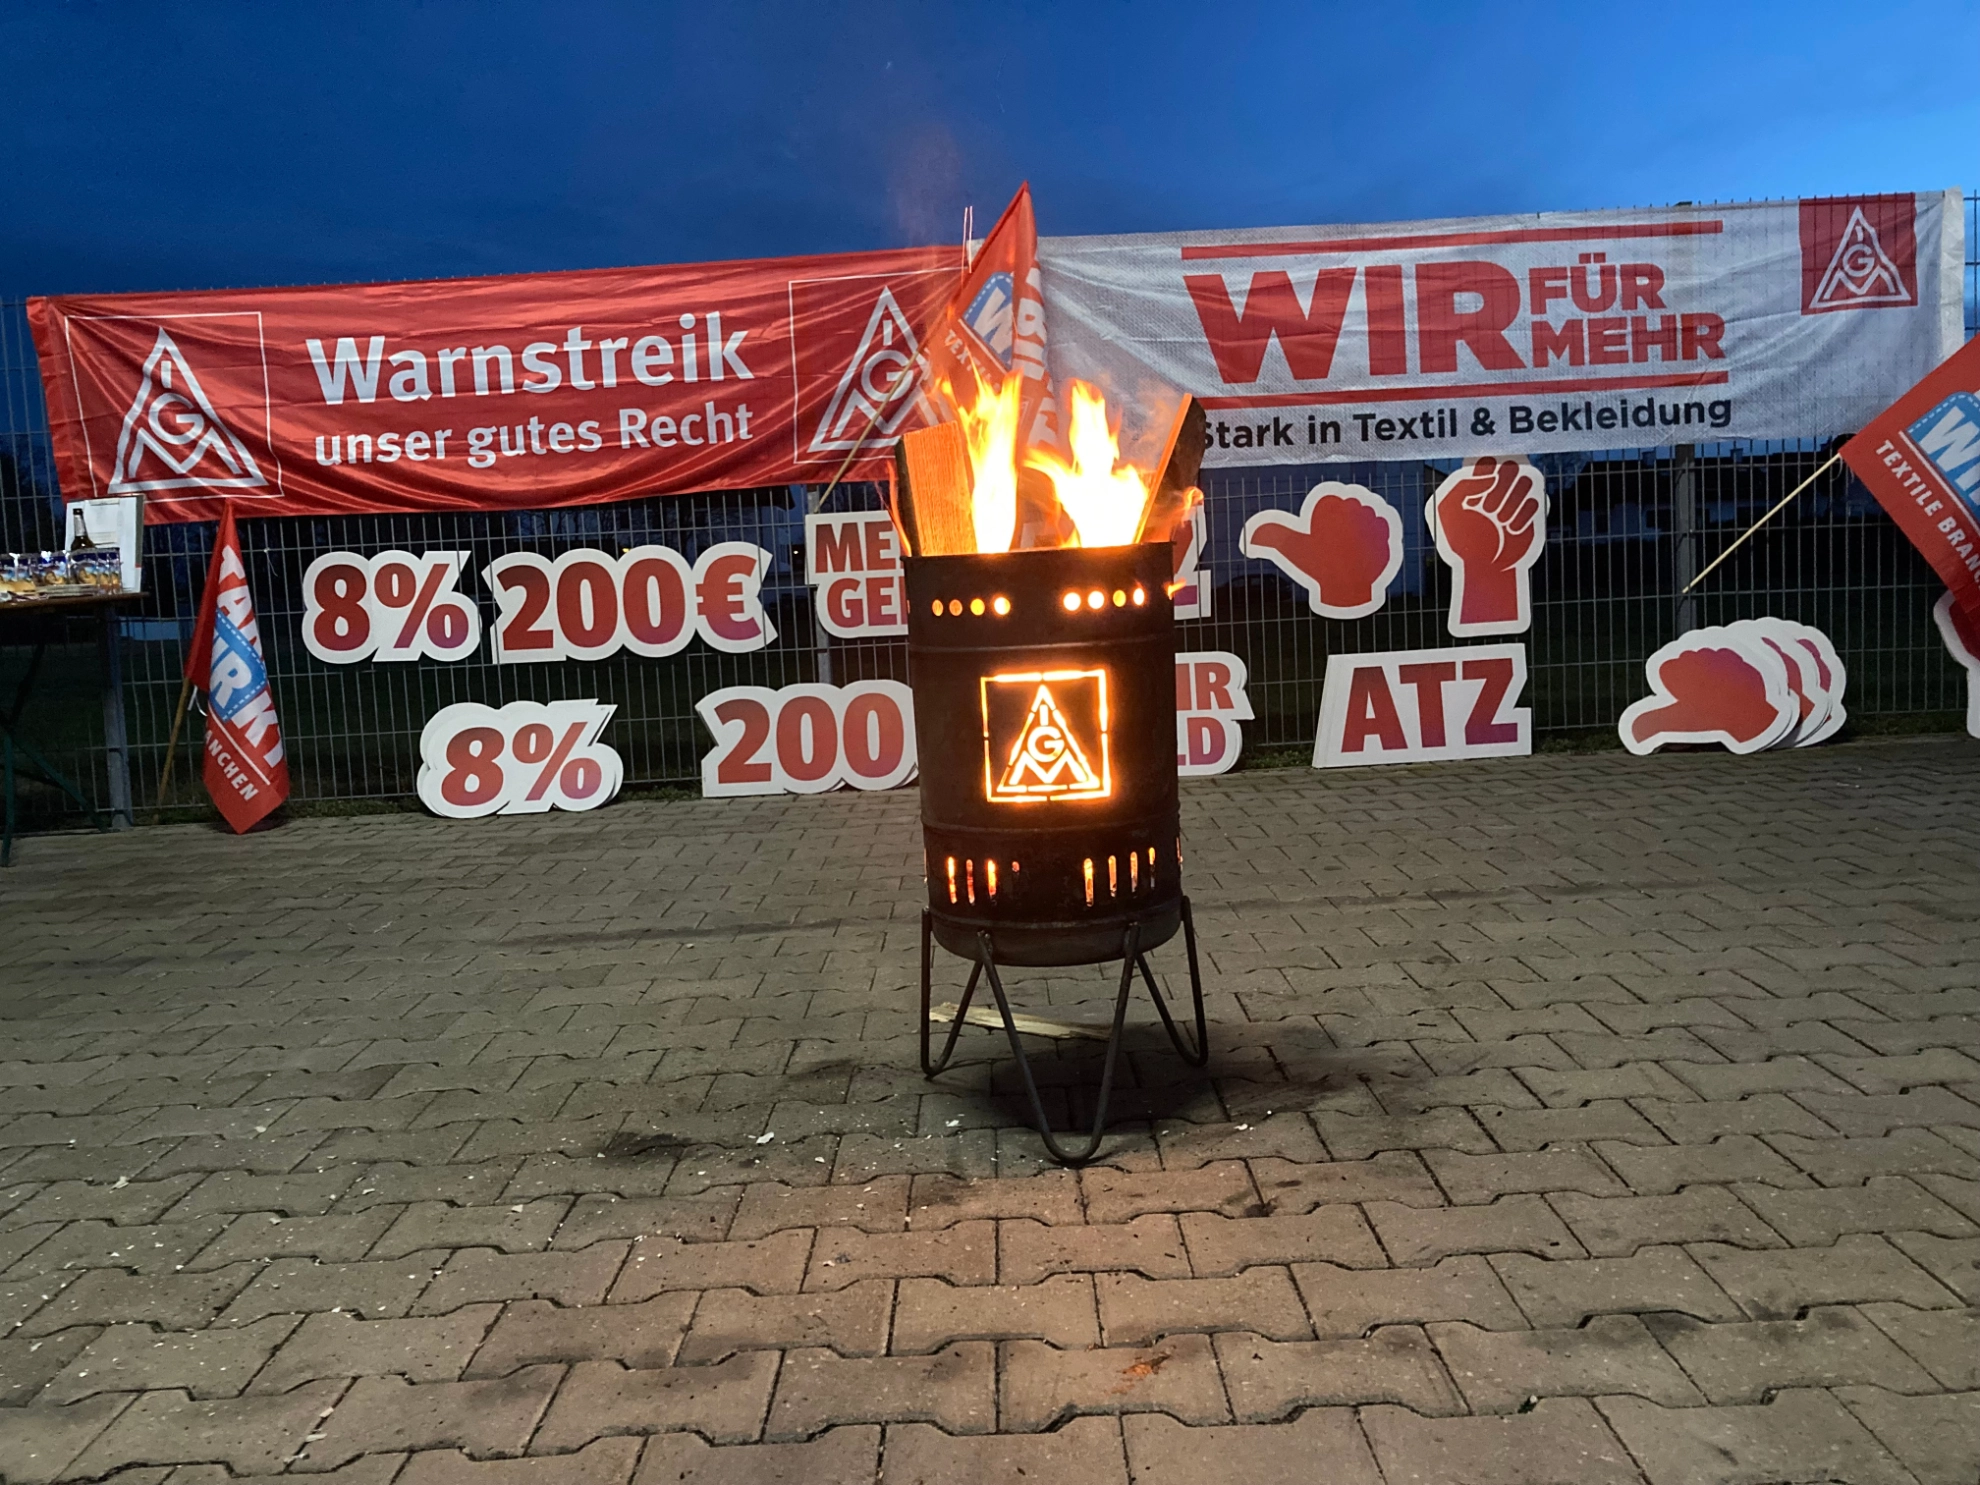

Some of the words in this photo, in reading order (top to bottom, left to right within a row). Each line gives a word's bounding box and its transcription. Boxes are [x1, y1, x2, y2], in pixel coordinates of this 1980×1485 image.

[1183, 260, 1527, 384] WIR
[1529, 252, 1667, 315] FÜR
[306, 311, 754, 405] Warnstreik
[1532, 311, 1726, 368] MEHR
[315, 428, 452, 466] unser
[467, 416, 602, 469] gutes
[619, 400, 753, 450] Recht
[1308, 405, 1341, 445] in
[1353, 408, 1457, 442] Textil
[1470, 407, 1496, 436] &
[1510, 397, 1732, 433] Bekleidung
[815, 521, 904, 573] ME
[1876, 439, 1944, 517] TEXTILE
[1937, 516, 1980, 590] BRAN
[313, 562, 469, 651] 8%
[496, 554, 762, 650] 200€
[714, 693, 904, 784] 200
[1341, 658, 1518, 753] ATZ
[441, 722, 602, 806] 8%
